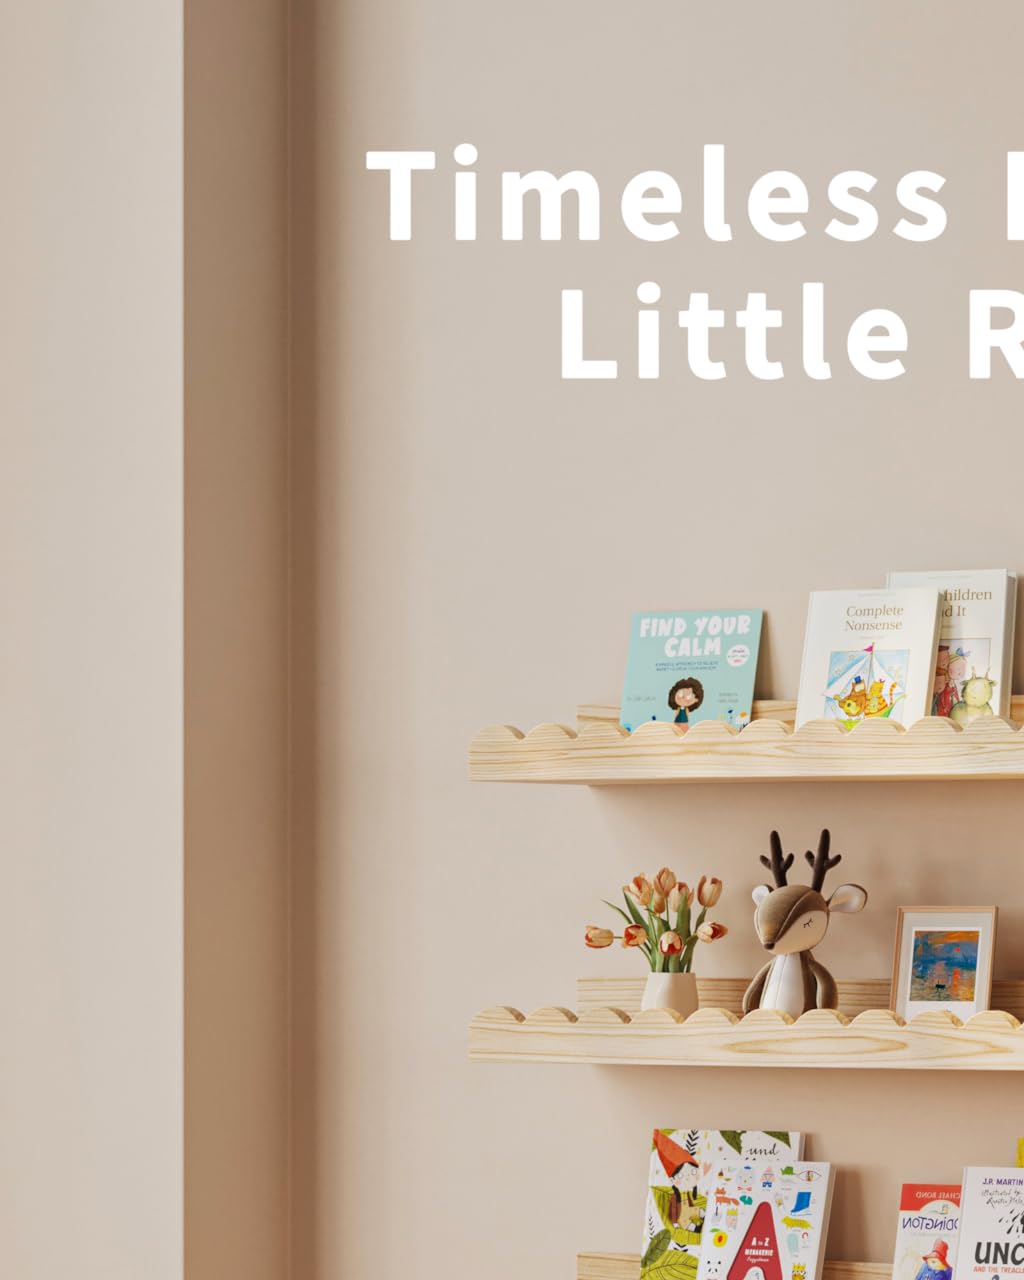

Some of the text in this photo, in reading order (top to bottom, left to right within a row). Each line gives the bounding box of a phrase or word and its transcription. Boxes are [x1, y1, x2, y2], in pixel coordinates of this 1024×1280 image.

[942, 588, 993, 601] hildren
[846, 604, 904, 619] Complete
[640, 615, 752, 638] FIND YOUR
[845, 619, 903, 632] Nonsense
[664, 636, 721, 658] CALM
[746, 1143, 780, 1156] und
[996, 1178, 1024, 1187] MARTIN
